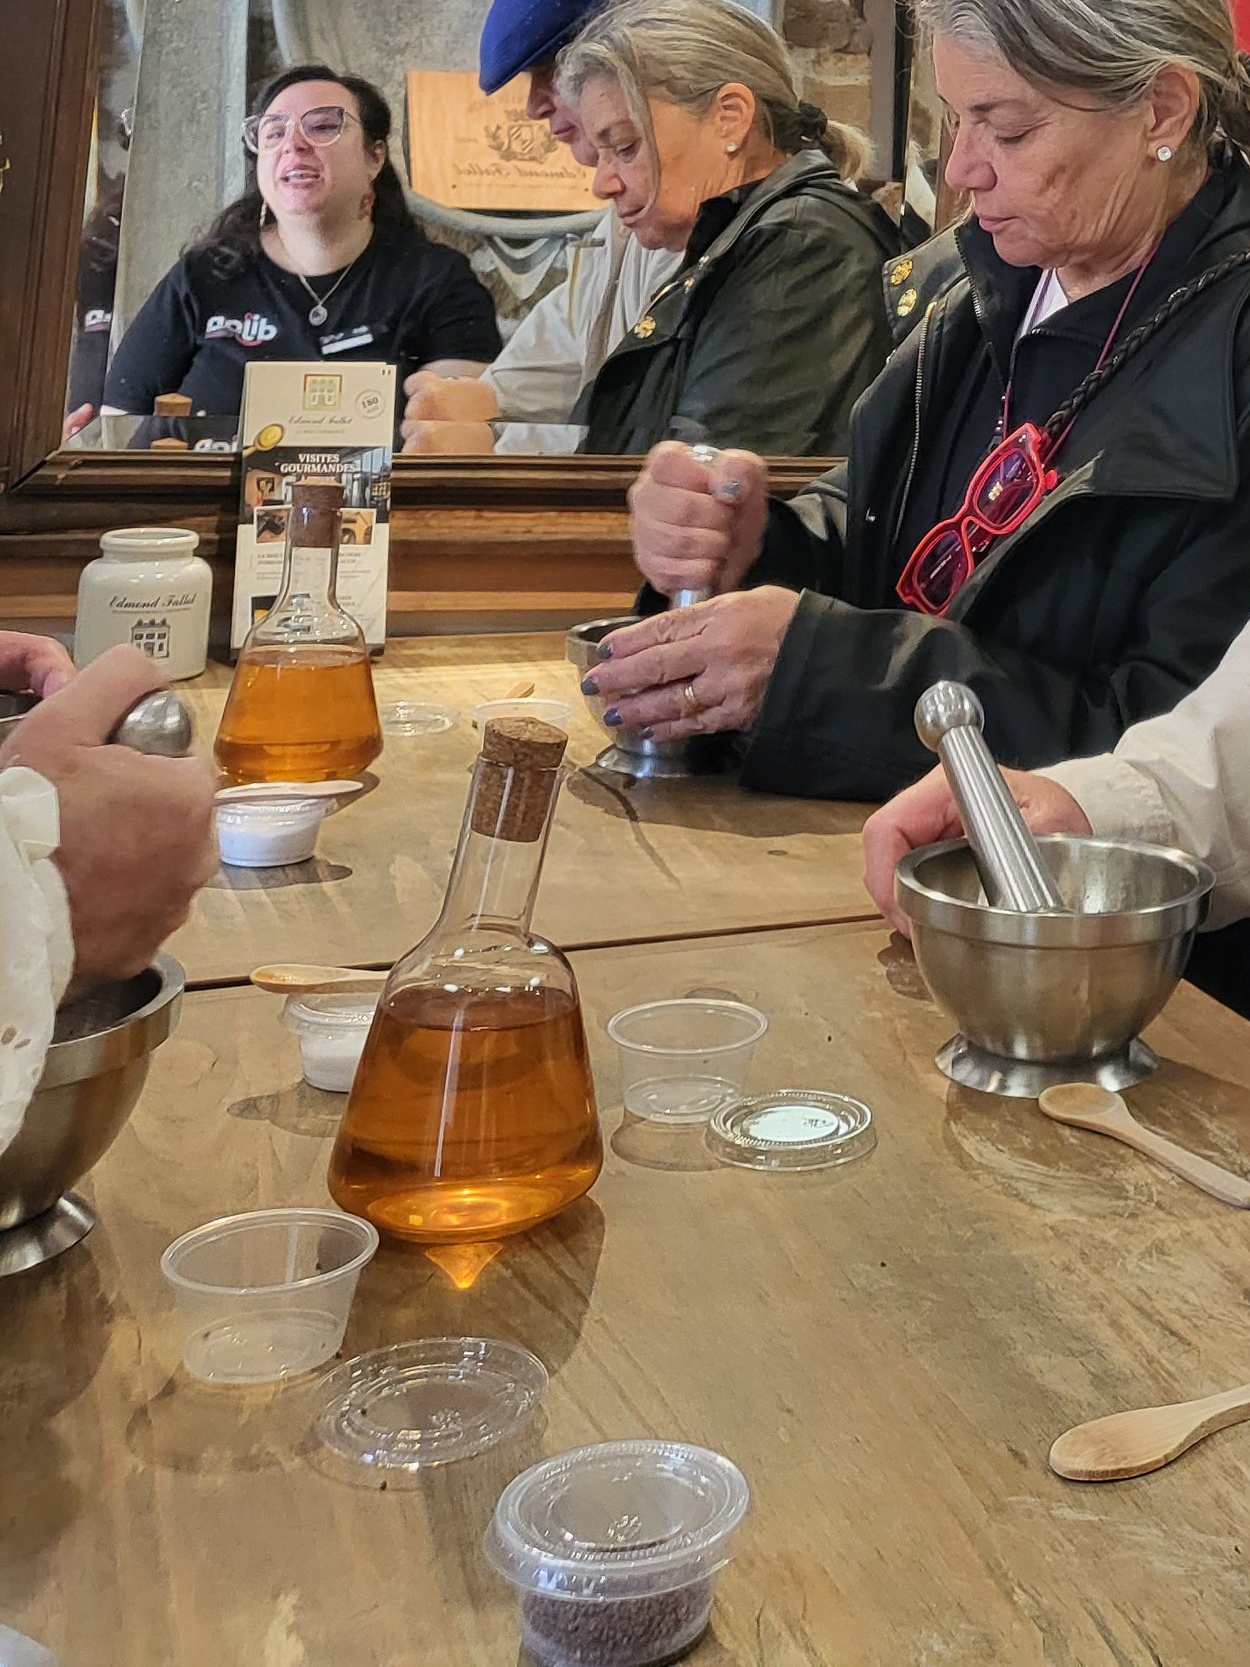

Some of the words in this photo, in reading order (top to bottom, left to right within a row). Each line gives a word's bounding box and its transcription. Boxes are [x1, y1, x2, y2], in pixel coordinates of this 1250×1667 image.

[298, 453, 340, 463] VISITES
[280, 462, 357, 474] GOURMANDES
[109, 595, 161, 608] Edmond
